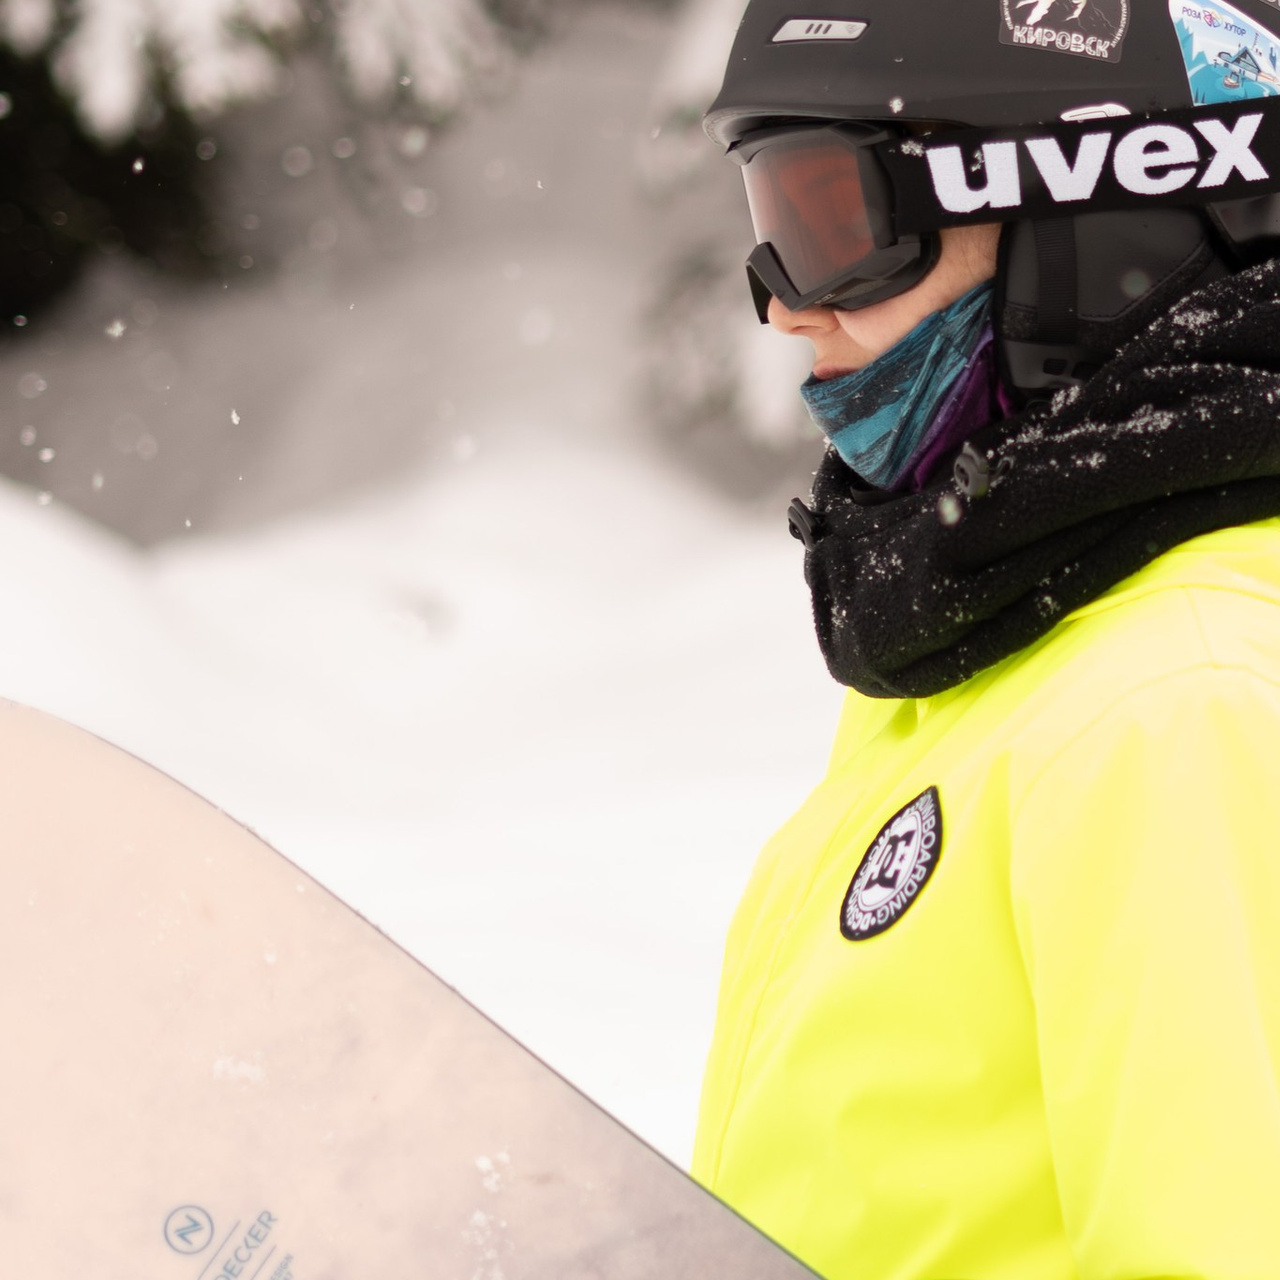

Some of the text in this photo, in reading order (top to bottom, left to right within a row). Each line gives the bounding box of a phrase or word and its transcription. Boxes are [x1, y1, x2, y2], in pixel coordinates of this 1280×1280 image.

[1181, 6, 1247, 37] РОЗА ХУТОР
[1012, 24, 1111, 58] КИРОВСК
[925, 113, 1270, 214] uvex
